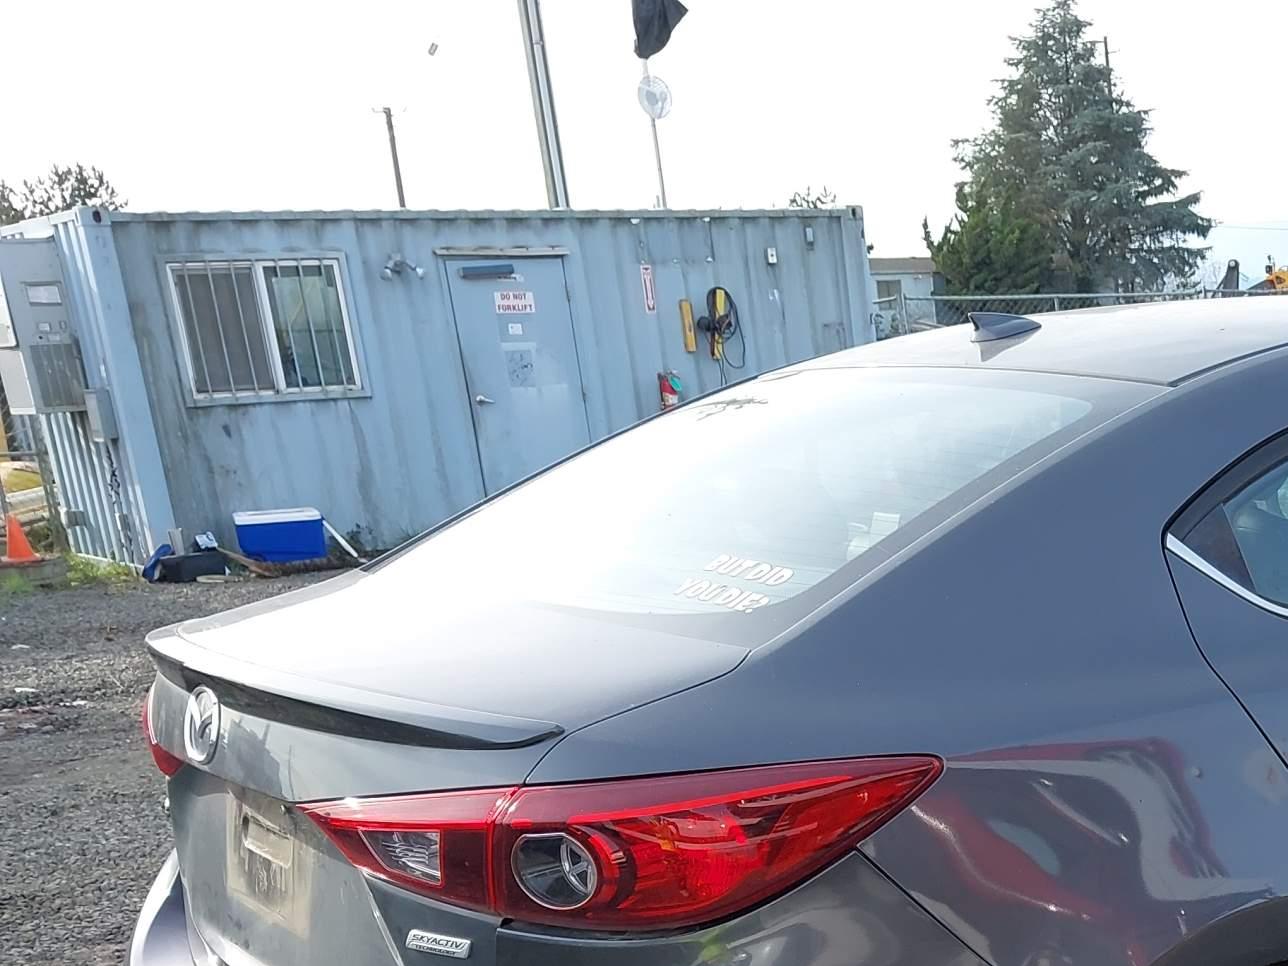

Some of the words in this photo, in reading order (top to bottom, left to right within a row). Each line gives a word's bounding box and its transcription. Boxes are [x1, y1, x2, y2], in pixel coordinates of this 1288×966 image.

[500, 293, 511, 301] DO
[512, 293, 527, 301] NOT
[497, 303, 533, 312] FORKLIFT
[704, 553, 758, 577] BUT
[744, 560, 795, 586] DID
[673, 577, 727, 601] YOU
[714, 587, 769, 614] DIE?
[411, 934, 464, 949] SKYACTIV
